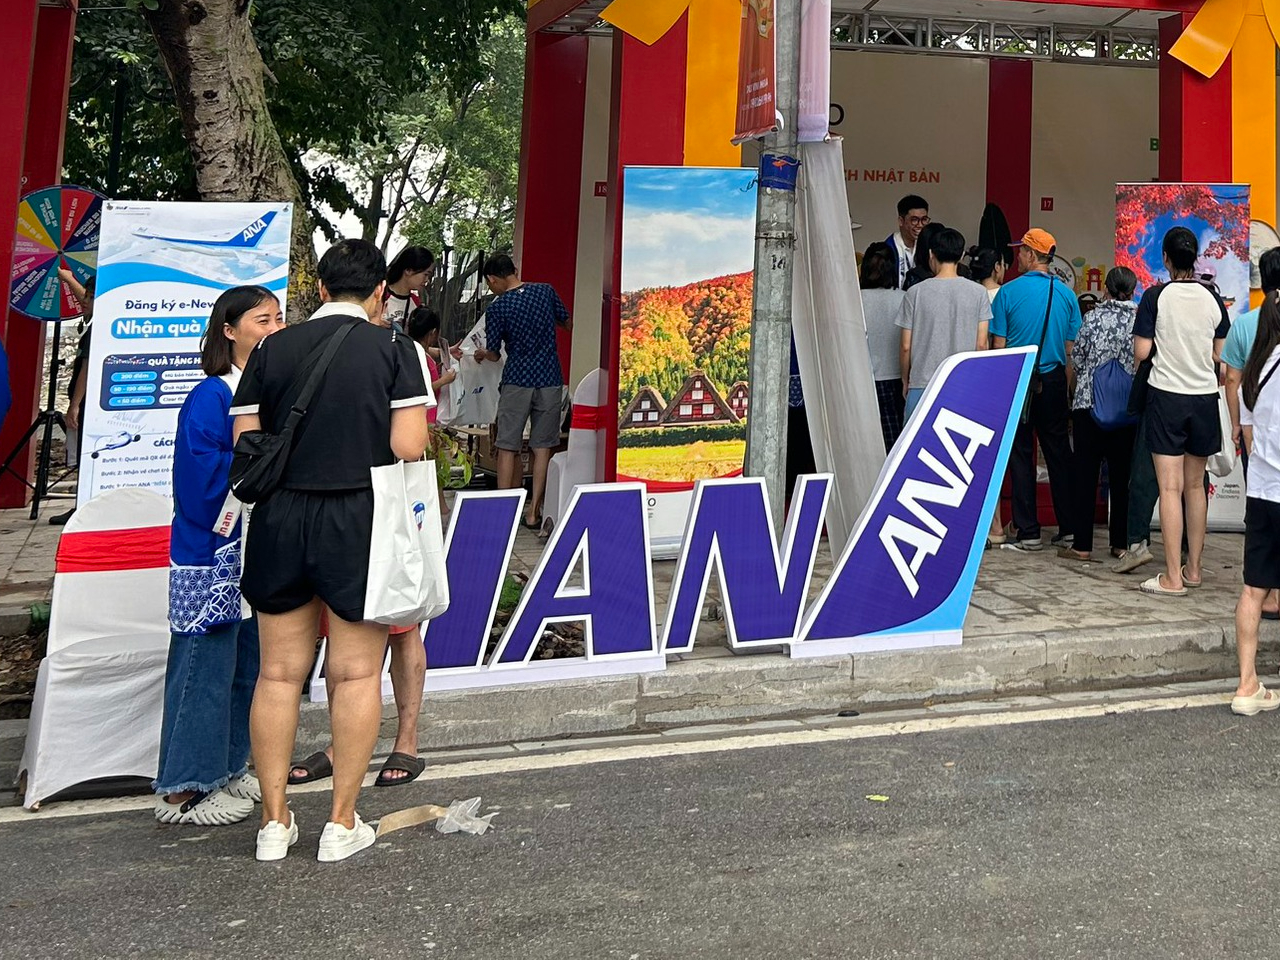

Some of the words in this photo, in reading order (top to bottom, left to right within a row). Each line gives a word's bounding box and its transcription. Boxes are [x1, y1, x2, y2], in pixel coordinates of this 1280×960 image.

[864, 168, 904, 184] NHẬT
[910, 168, 940, 183] BẢN
[1043, 200, 1052, 208] 17
[242, 218, 268, 242] ANA
[125, 300, 158, 312] Đăng
[162, 299, 176, 311] ký
[116, 320, 164, 337] Nhận
[168, 319, 200, 337] quà
[148, 356, 166, 366] QUÀ
[169, 355, 193, 366] TẶNG
[878, 407, 995, 598] ANA
